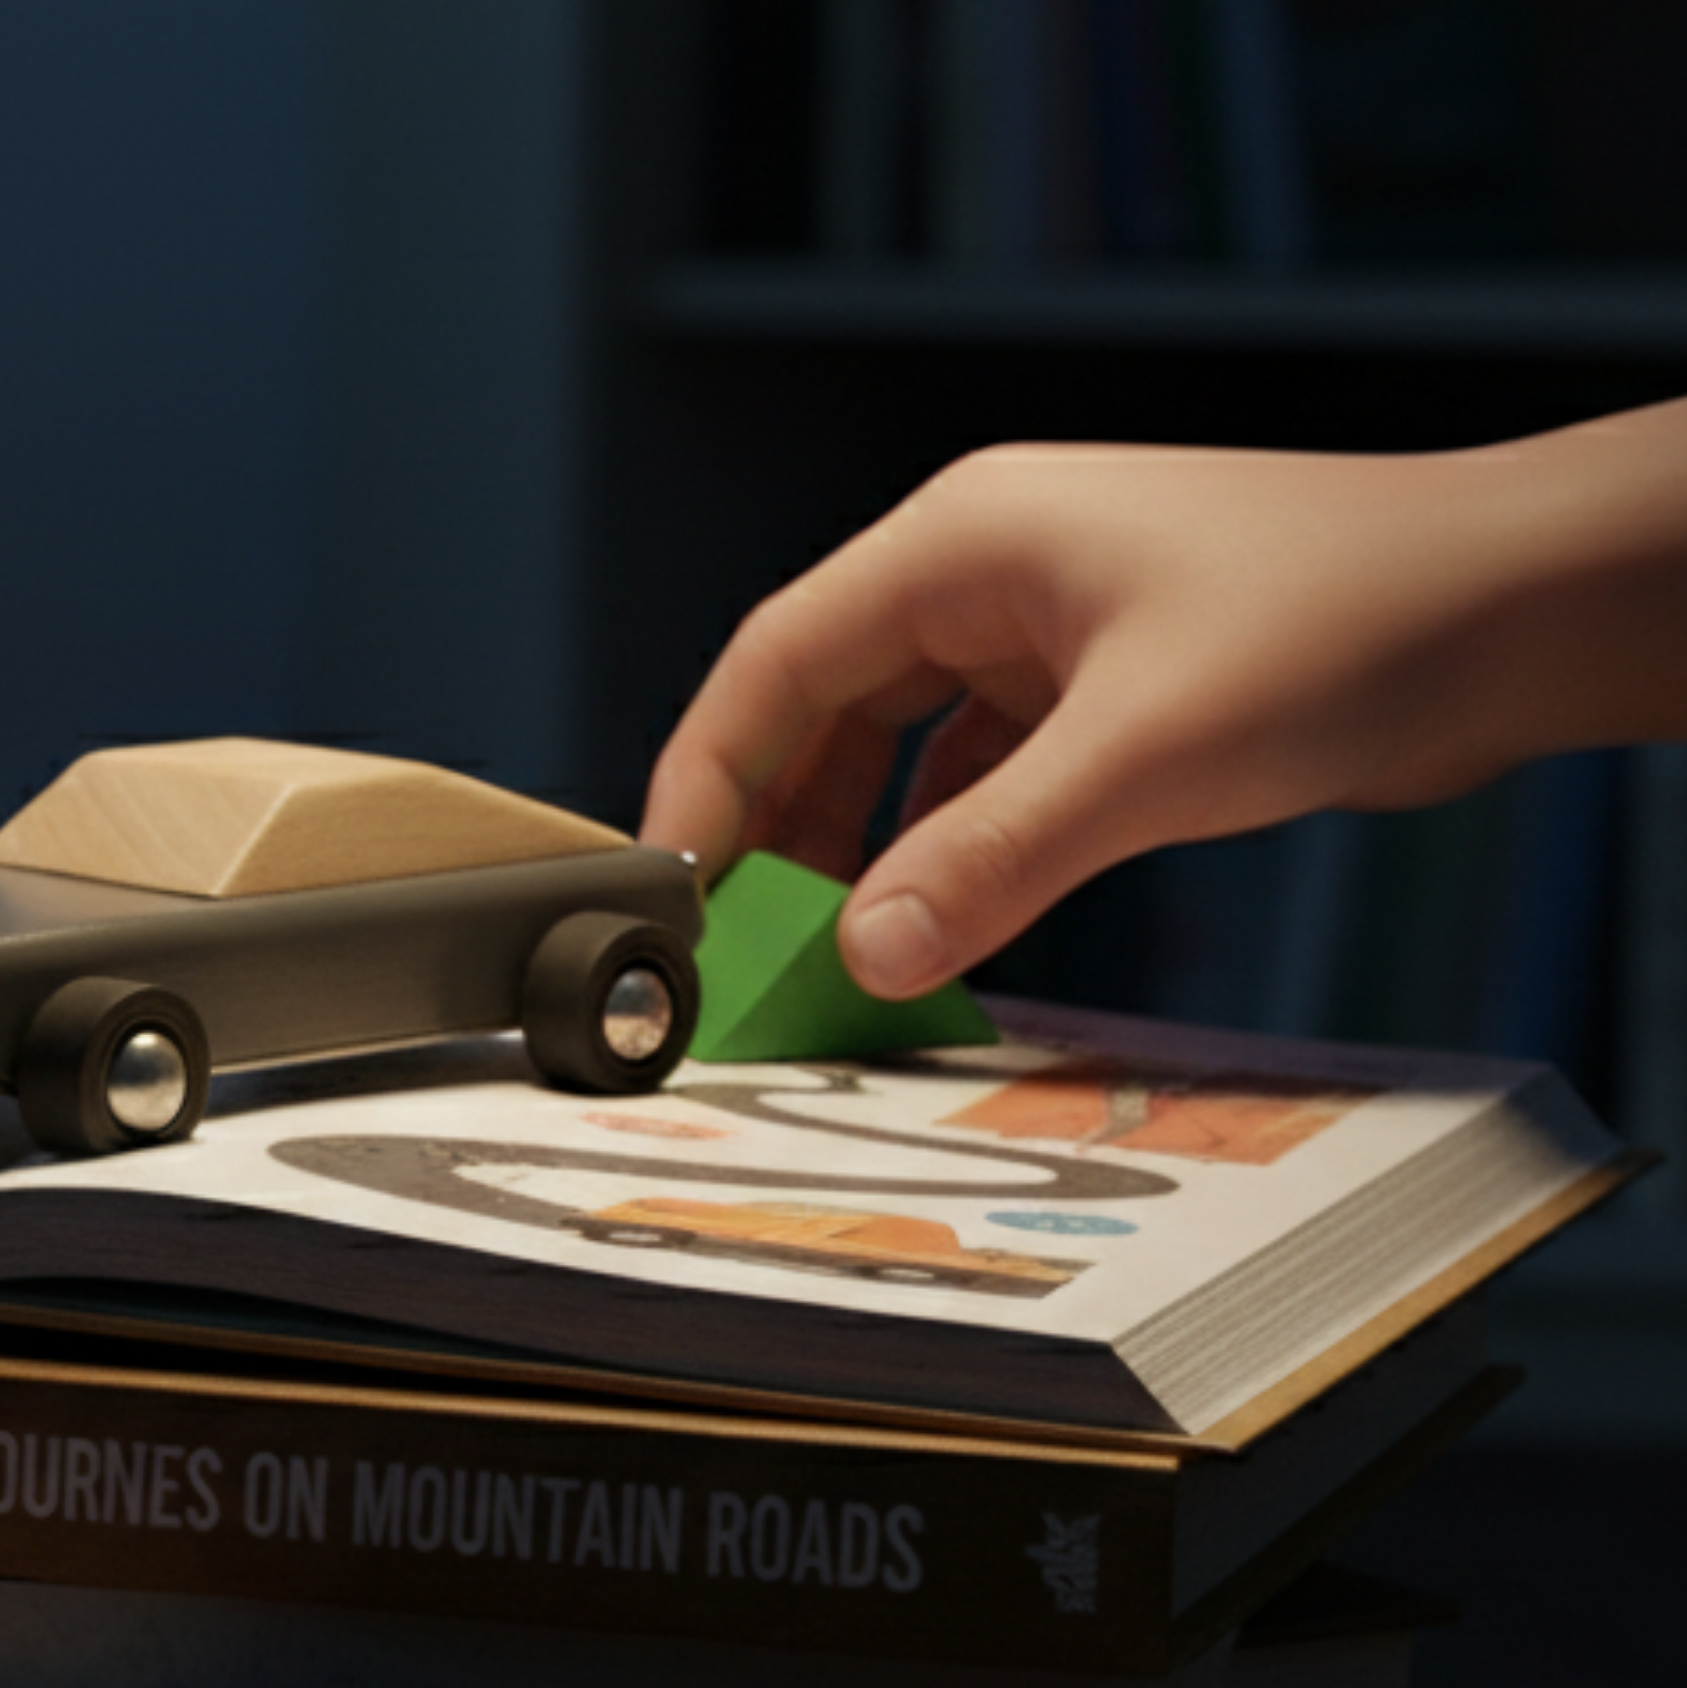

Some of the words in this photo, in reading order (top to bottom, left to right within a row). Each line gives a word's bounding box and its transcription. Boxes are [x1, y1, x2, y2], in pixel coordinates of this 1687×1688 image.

[242, 1451, 328, 1542] ON
[350, 1461, 683, 1575] MOUNTAIN
[707, 1491, 925, 1594] ROADS
